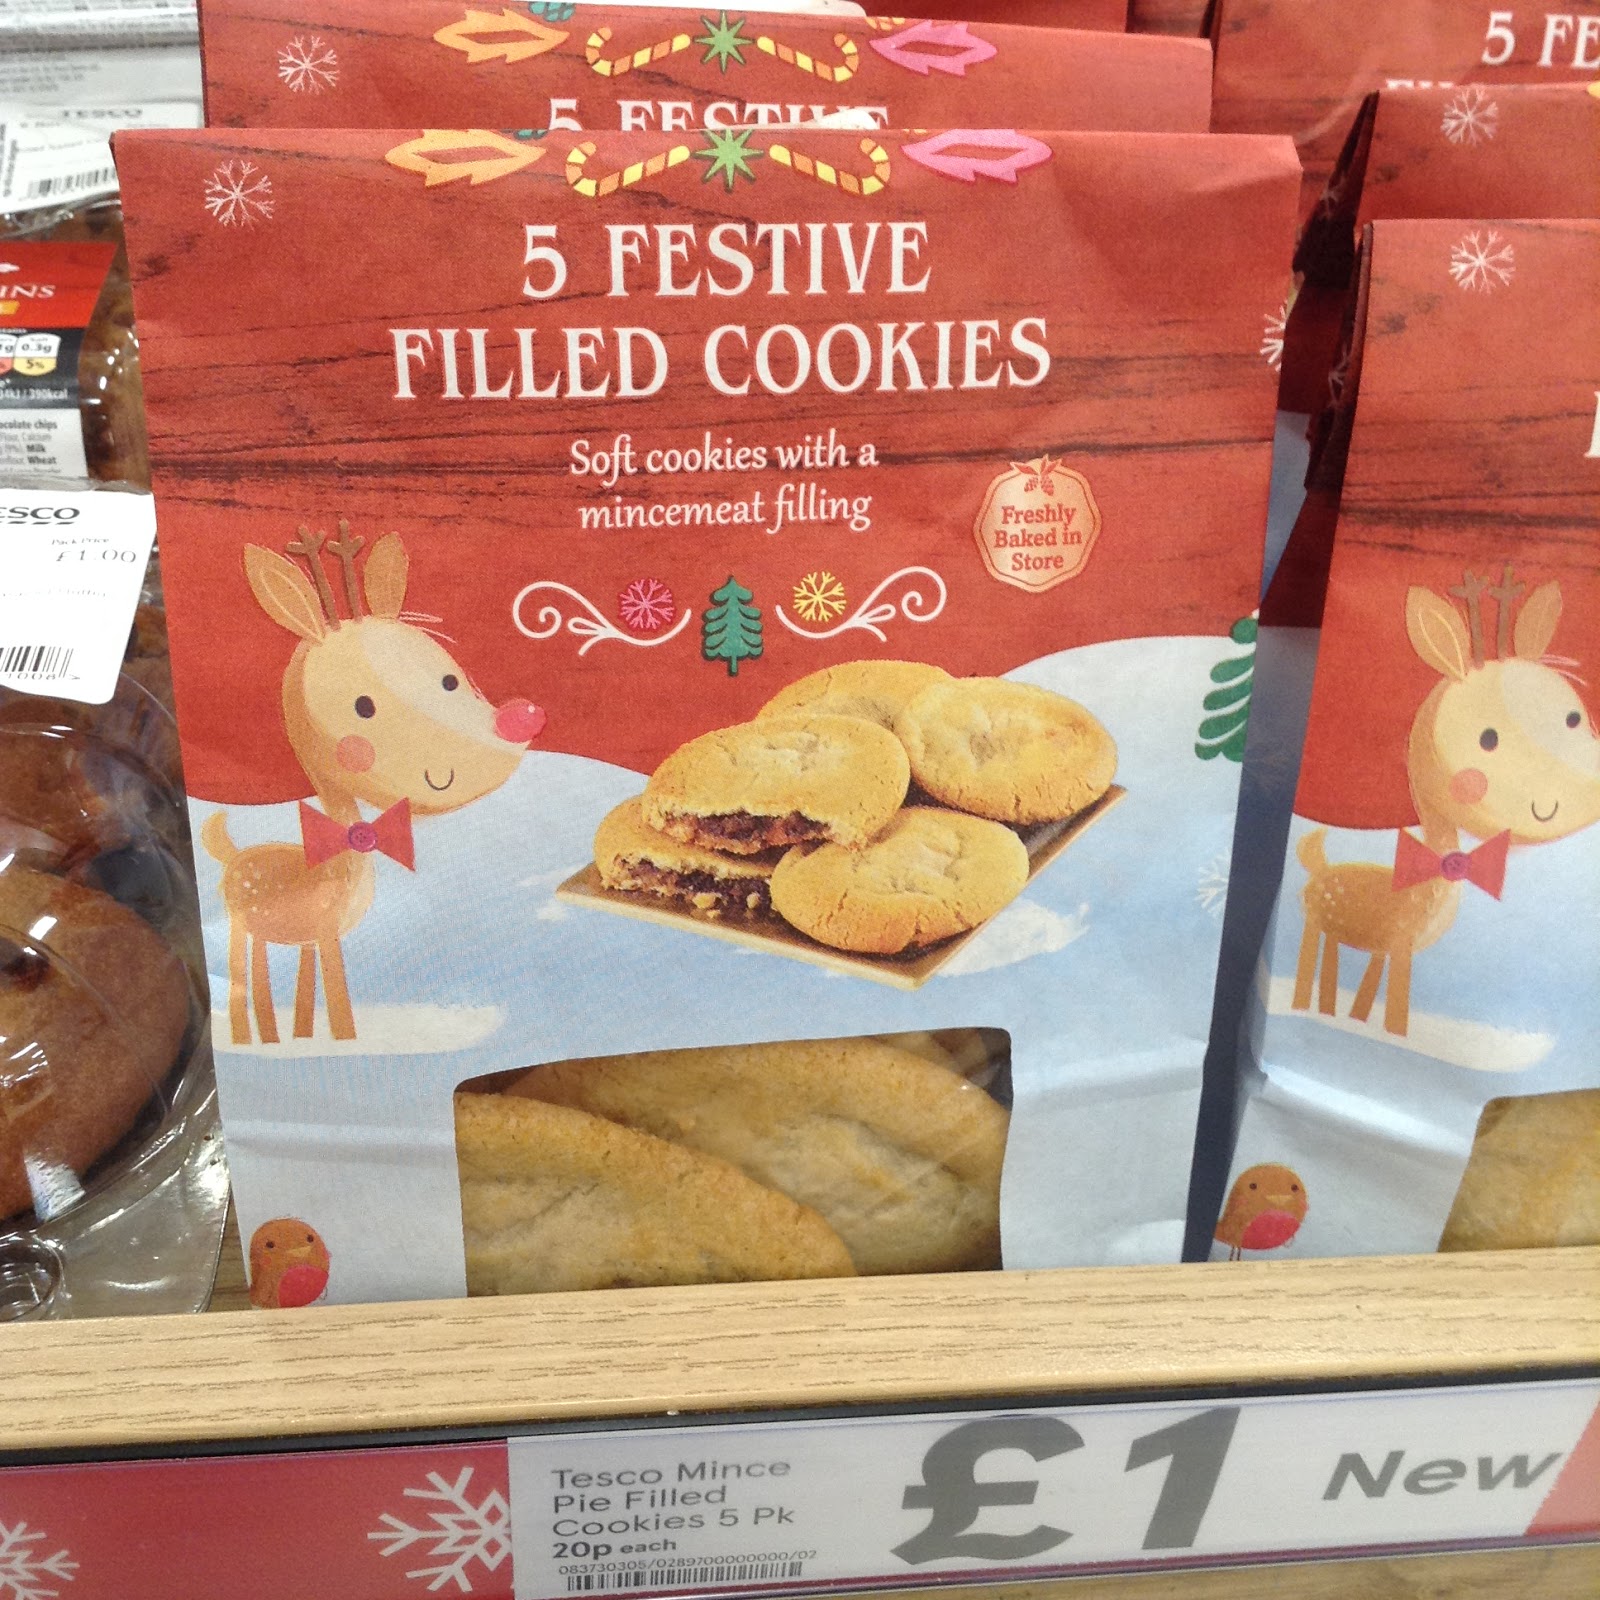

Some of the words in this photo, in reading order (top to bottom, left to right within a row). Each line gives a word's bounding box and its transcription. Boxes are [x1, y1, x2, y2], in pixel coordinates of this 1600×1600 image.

[1481, 11, 1515, 65] 5
[617, 99, 889, 131] FEST
[522, 225, 568, 298] 5
[606, 221, 932, 297] FESTIVE
[390, 327, 669, 401] FILLED
[704, 317, 1053, 396] COOKIES
[570, 434, 638, 487] Soft
[646, 431, 767, 472] cookies
[775, 427, 850, 468] with
[857, 442, 880, 467] a
[578, 491, 766, 529] mincemeat
[765, 482, 873, 535] filling
[1001, 503, 1077, 527] Freshly
[994, 527, 1058, 548] Baked
[1062, 526, 1083, 545] in
[56, 549, 137, 563] £1.00
[1011, 552, 1065, 571] Store
[551, 1466, 664, 1490] Tesco
[677, 1459, 792, 1482] Mince
[889, 1406, 1242, 1566] £1
[1322, 1449, 1563, 1501] New
[554, 1492, 612, 1514] Pie
[625, 1485, 727, 1510] Filled
[553, 1512, 706, 1537] Cookies
[718, 1508, 740, 1527] 5
[752, 1505, 796, 1526] Pk
[553, 1541, 612, 1560] 20p
[620, 1539, 677, 1554] each
